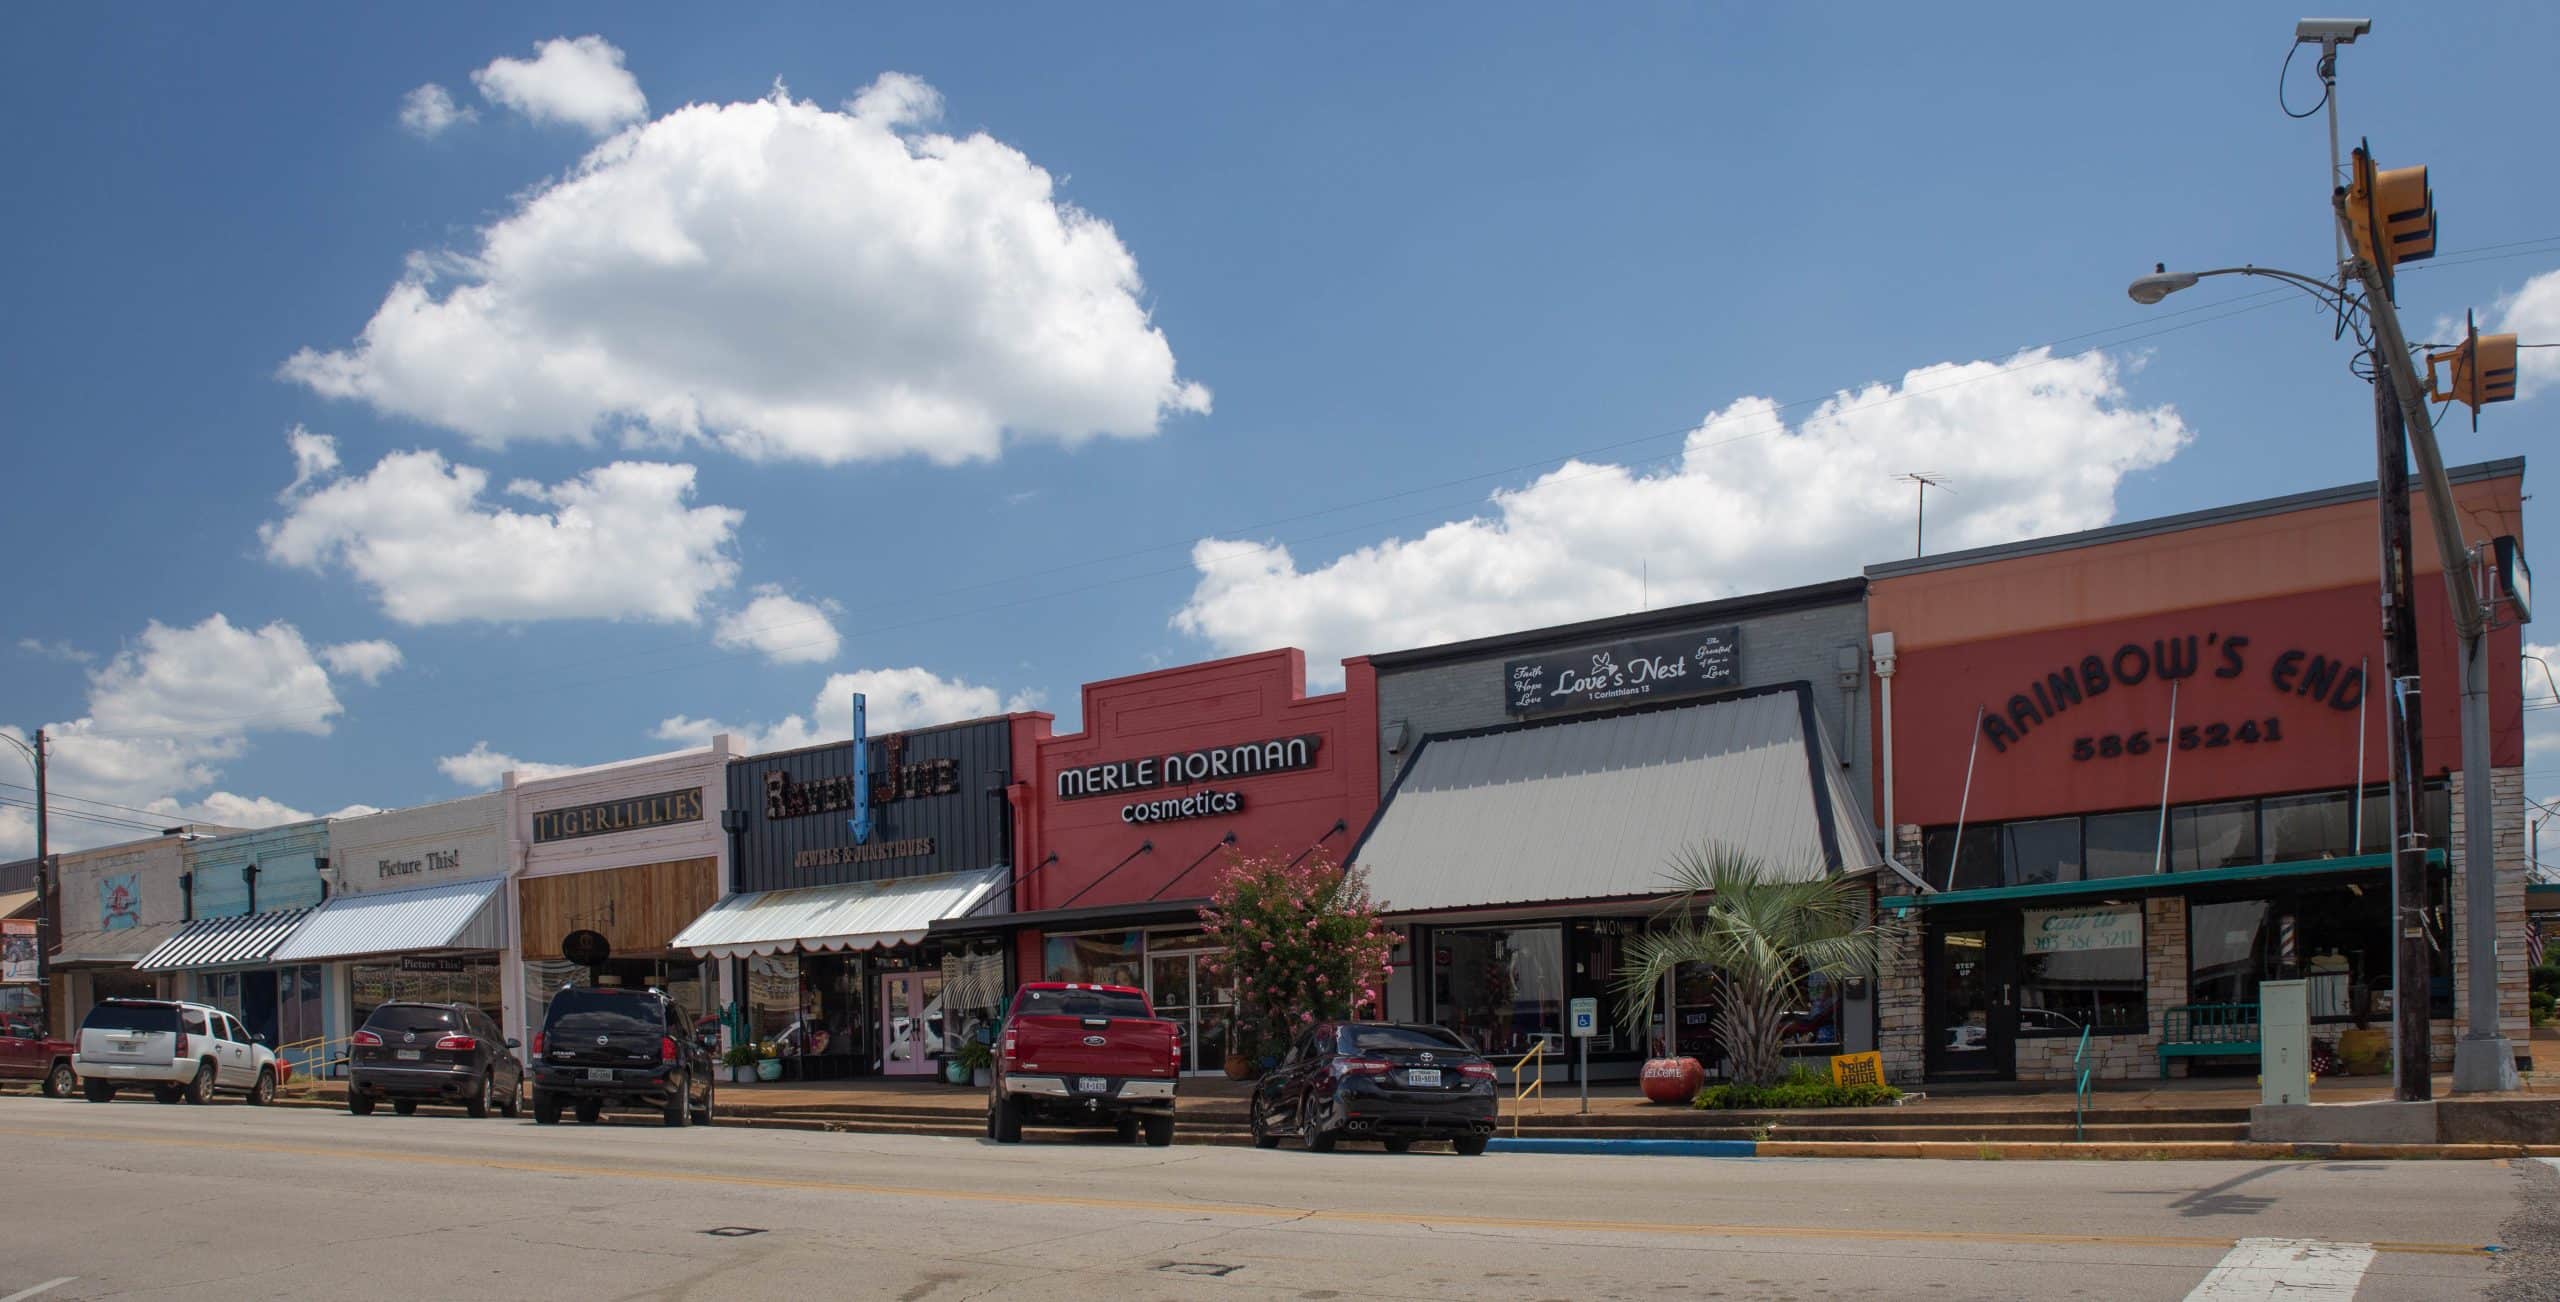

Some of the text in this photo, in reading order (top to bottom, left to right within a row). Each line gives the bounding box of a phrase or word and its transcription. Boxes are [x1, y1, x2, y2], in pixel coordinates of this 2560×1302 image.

[1513, 665, 1543, 680] Faith
[1550, 655, 1688, 697] Love's Nest
[1702, 665, 1730, 679] Love
[1514, 678, 1542, 696] Hope
[1515, 693, 1542, 706] Love
[1588, 684, 1651, 701] 1 Corinthians 13
[1983, 632, 2370, 753] RAINBOW'S END
[2072, 717, 2283, 762] 586-5241
[1057, 738, 1308, 796] MERLE NORMAN
[535, 789, 701, 841] TIGERLILLIES
[1121, 789, 1238, 823] cosmetics
[378, 848, 459, 878] Picture This!
[794, 838, 932, 868] JEWELS & JUNKTIQUES
[1594, 919, 1624, 936] AVON
[2042, 912, 2088, 932] Call
[404, 958, 462, 969] Picture This!
[1644, 1067, 1682, 1078] WELCOME
[1839, 1056, 1877, 1087] TRIBE PRIDE
